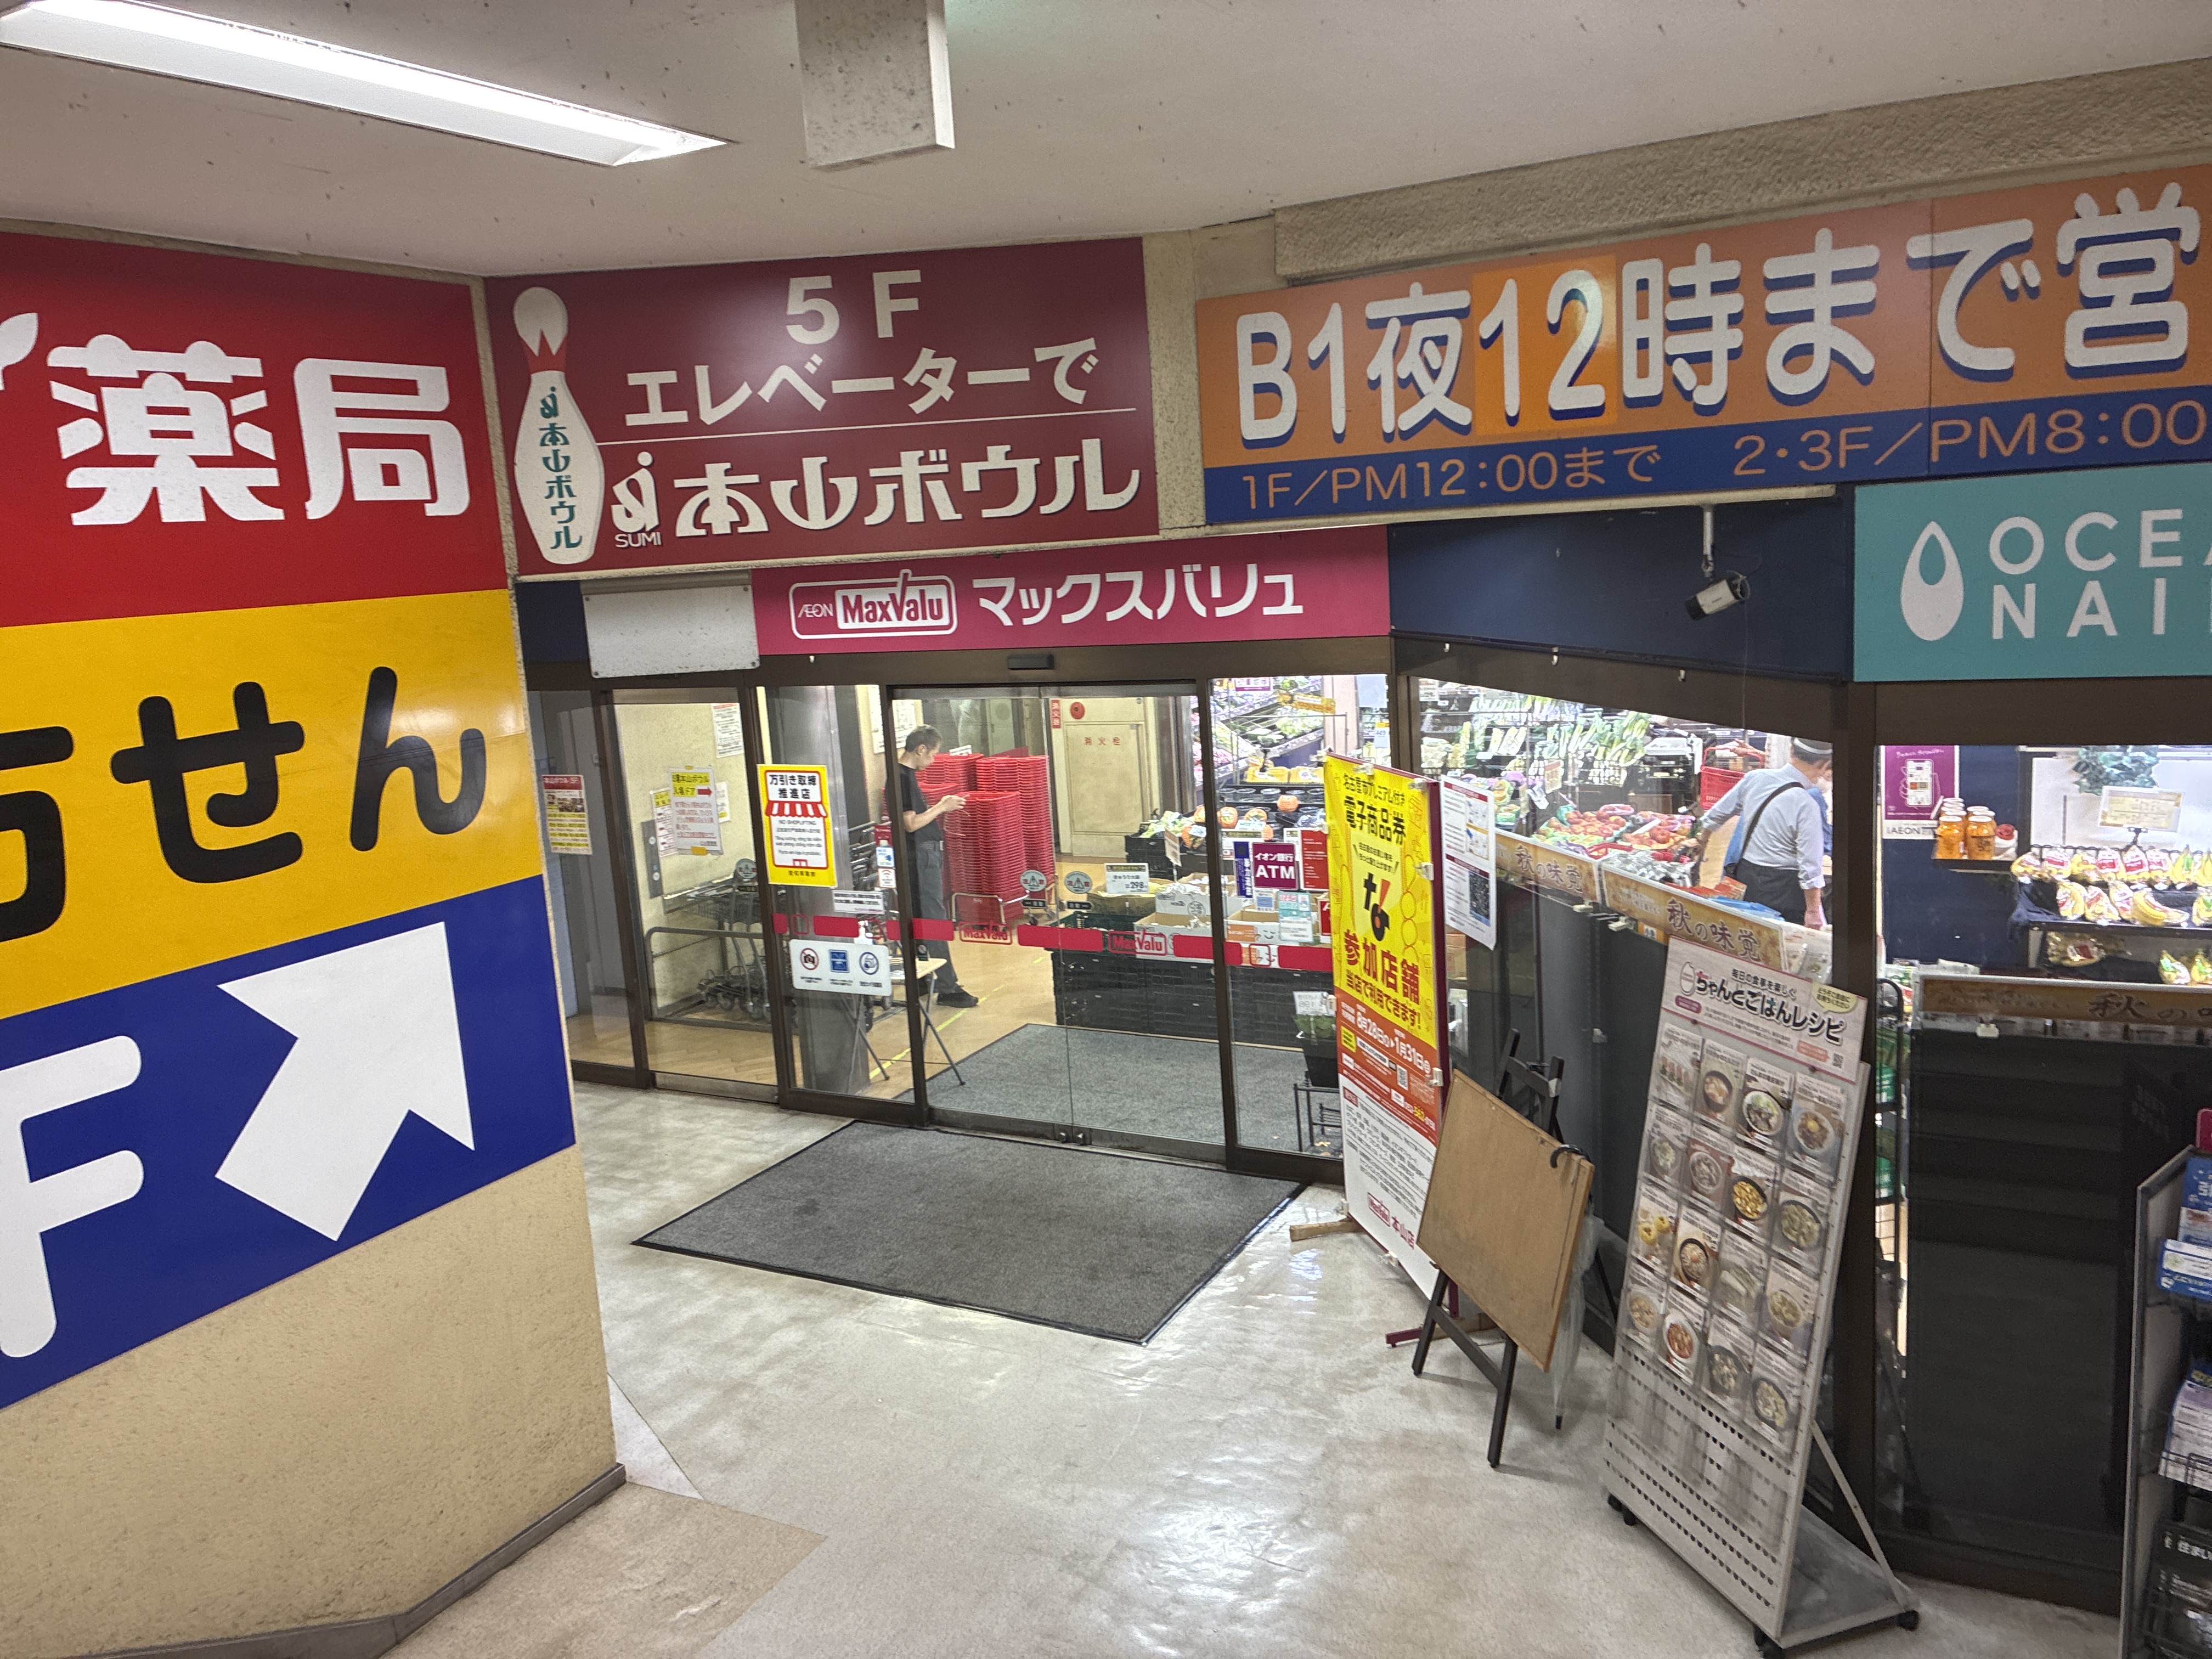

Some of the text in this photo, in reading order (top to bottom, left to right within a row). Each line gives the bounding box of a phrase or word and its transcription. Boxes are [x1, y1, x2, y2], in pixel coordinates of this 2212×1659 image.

[625, 337, 1098, 426] エレベーターで
[47, 334, 471, 526] 薬局
[538, 422, 583, 550] 本山ボウル
[674, 439, 1140, 538] 本山ボウル
[614, 532, 662, 549] SUMI
[1989, 509, 2212, 575] OCE
[843, 569, 944, 624] MaxValu
[972, 563, 1304, 626] マックスバリュ
[1992, 578, 2212, 640] NAI
[1344, 795, 1406, 845] 電子商品券
[1254, 852, 1294, 862] イオン銀行
[1255, 865, 1295, 879] ATM
[1515, 843, 1584, 894] 秋の味覚
[963, 920, 1008, 941] MaxValu
[1113, 928, 1164, 951] MaxValu
[1666, 898, 1762, 963] 秋の味覚
[1344, 928, 1421, 1005] 参加店舗
[1695, 970, 1847, 1043] ちゃんとごはんレシピ
